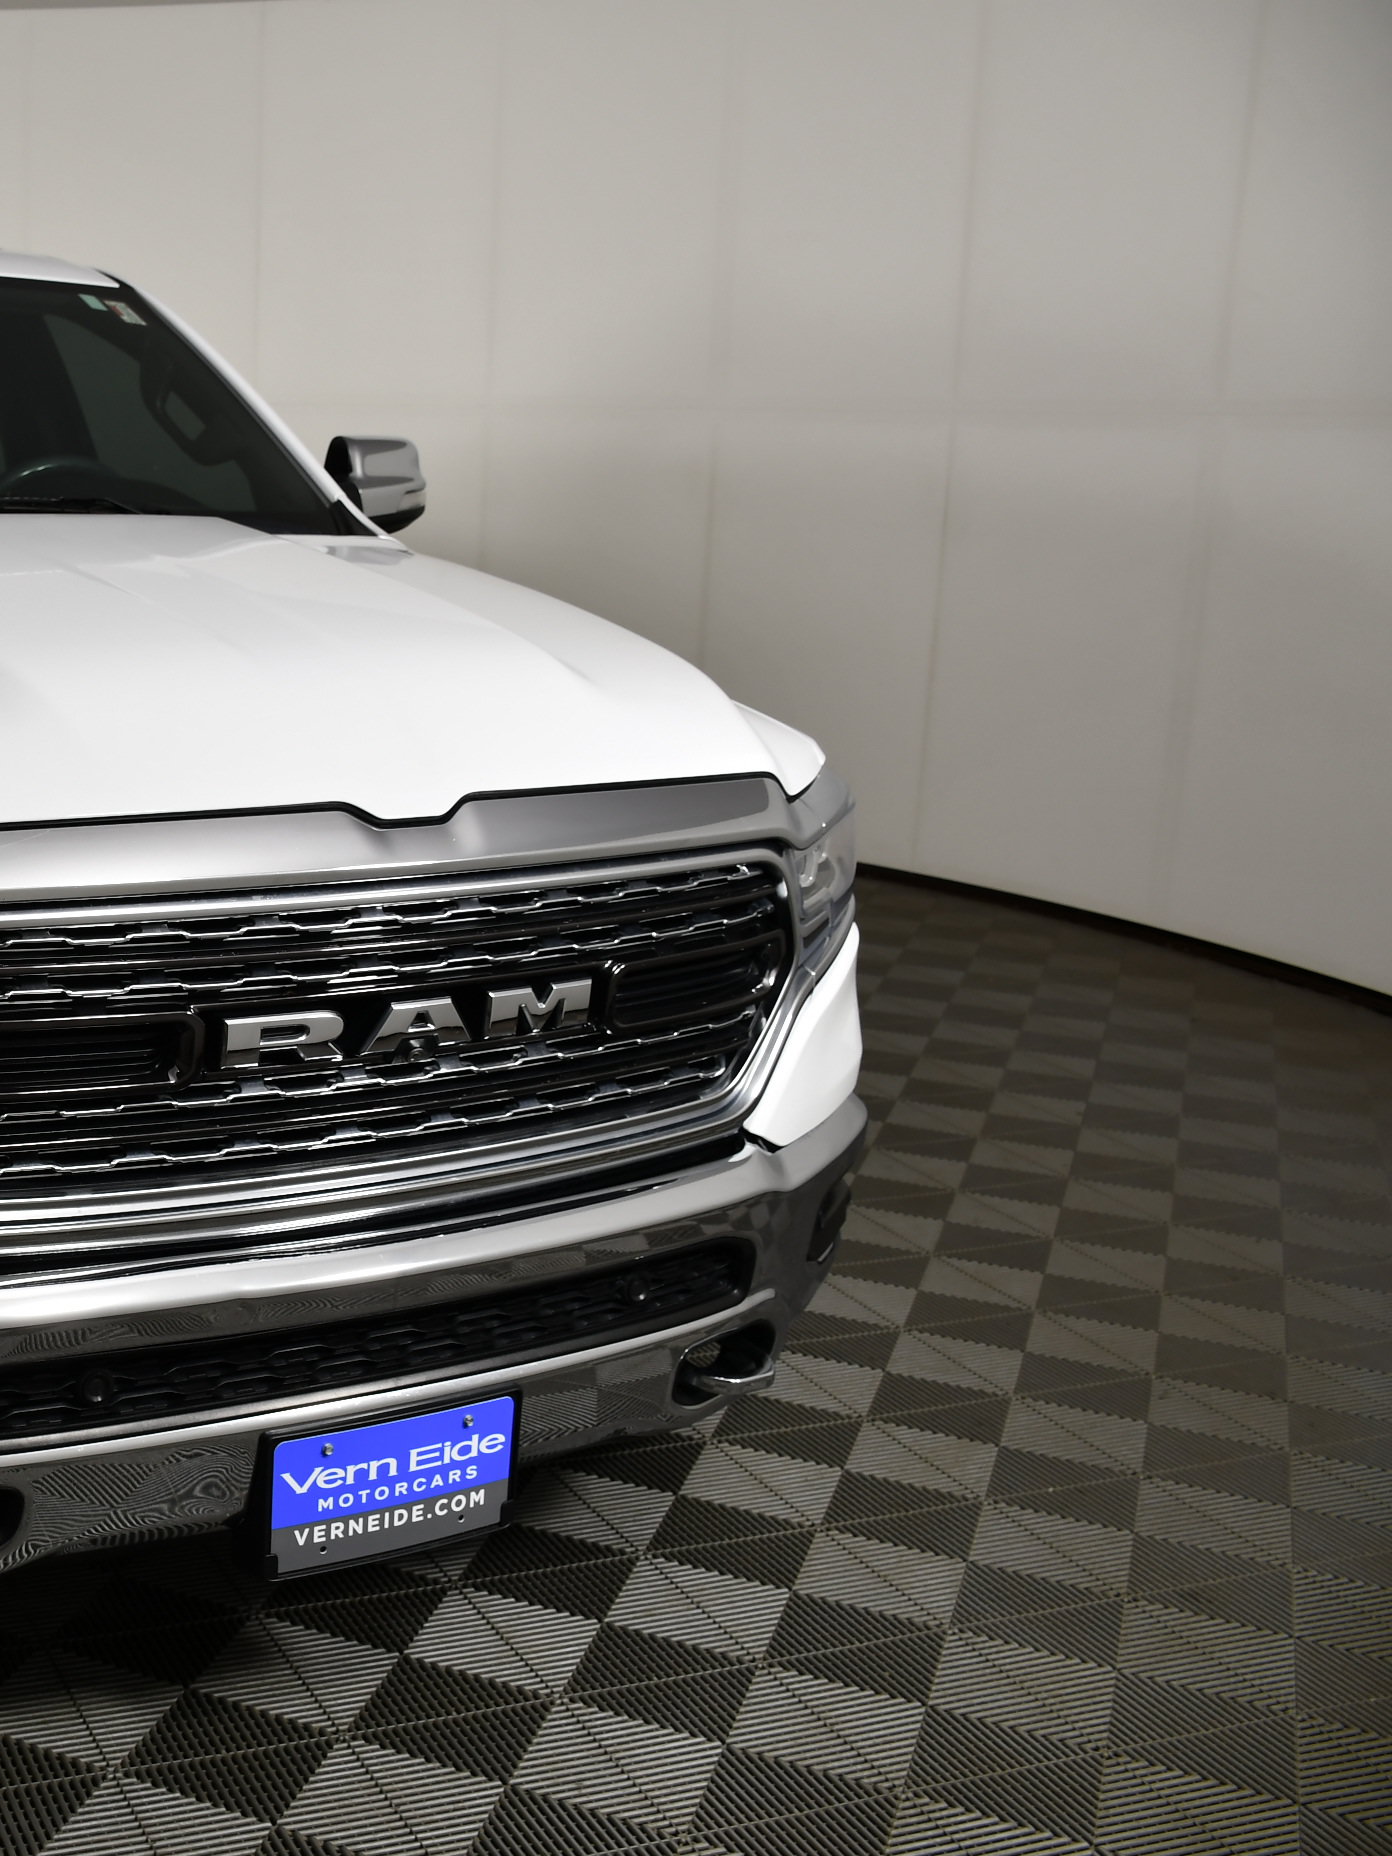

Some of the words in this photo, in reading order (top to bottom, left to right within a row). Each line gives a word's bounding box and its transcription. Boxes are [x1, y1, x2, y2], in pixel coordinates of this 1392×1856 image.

[220, 978, 593, 1069] RAM
[280, 1457, 398, 1495] Vern
[408, 1433, 506, 1472] Eide
[317, 1465, 479, 1512] MOTORCARS
[293, 1489, 486, 1546] VERNEIDE.COM
